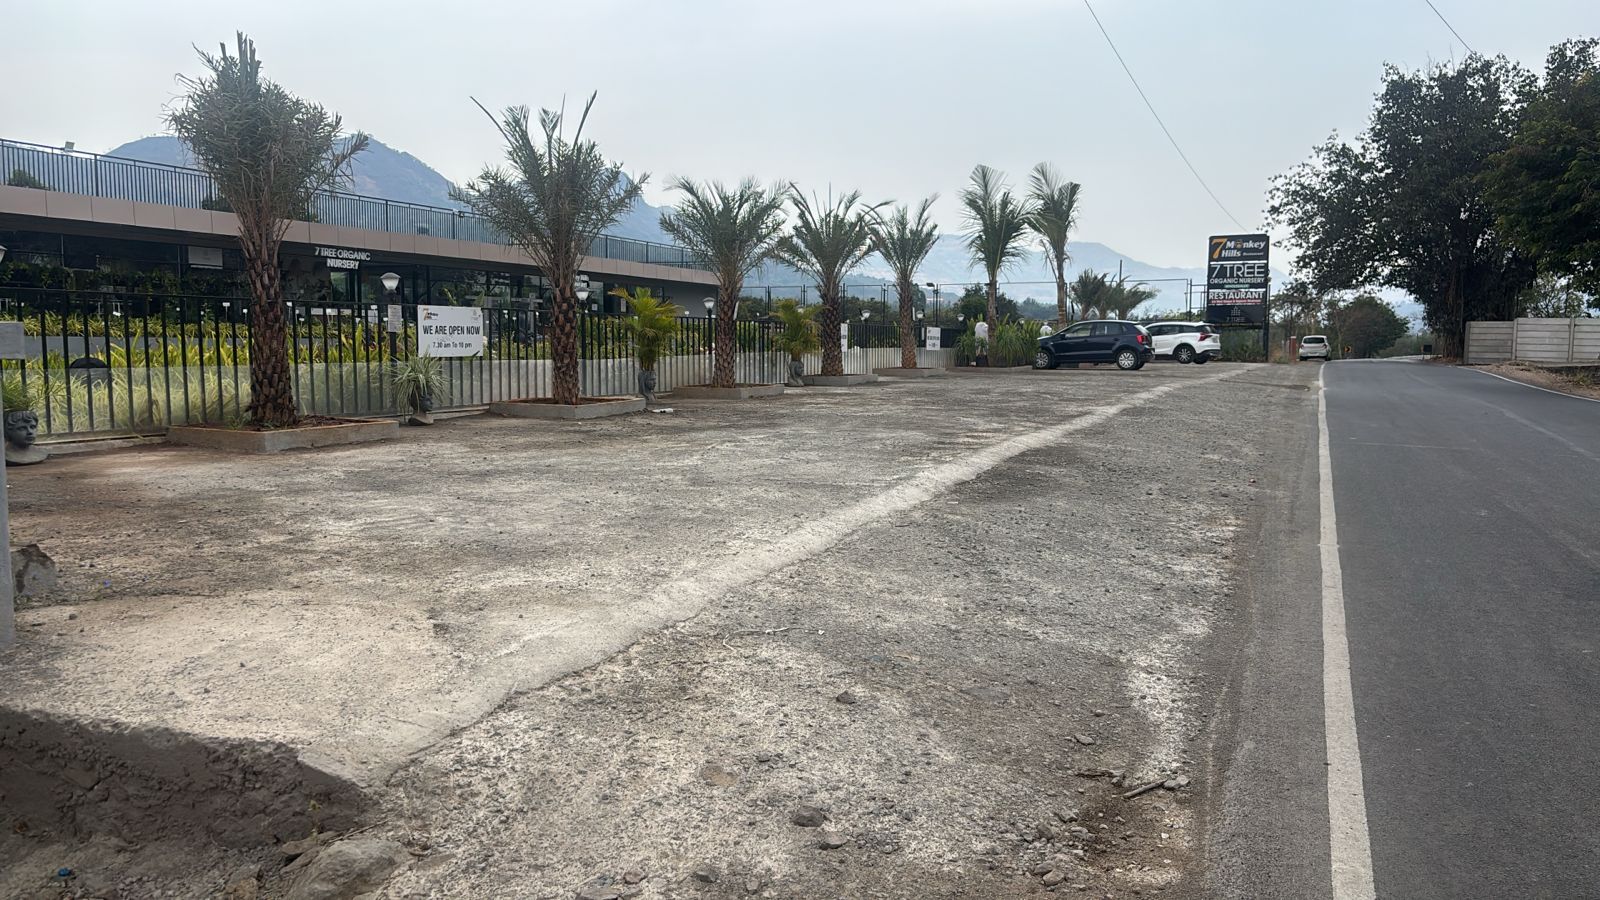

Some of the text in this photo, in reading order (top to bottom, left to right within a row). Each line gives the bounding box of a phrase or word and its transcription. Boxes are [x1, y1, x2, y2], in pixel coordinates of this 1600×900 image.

[315, 247, 371, 260] 7 TREE ORGANIC
[1211, 238, 1228, 259] 7
[1221, 249, 1241, 257] Hills
[327, 258, 360, 270] NURSERY
[1210, 263, 1265, 277] 7 TREE
[1209, 291, 1263, 299] RESTAURANT
[423, 325, 480, 335] WE ARE OPEN NOW
